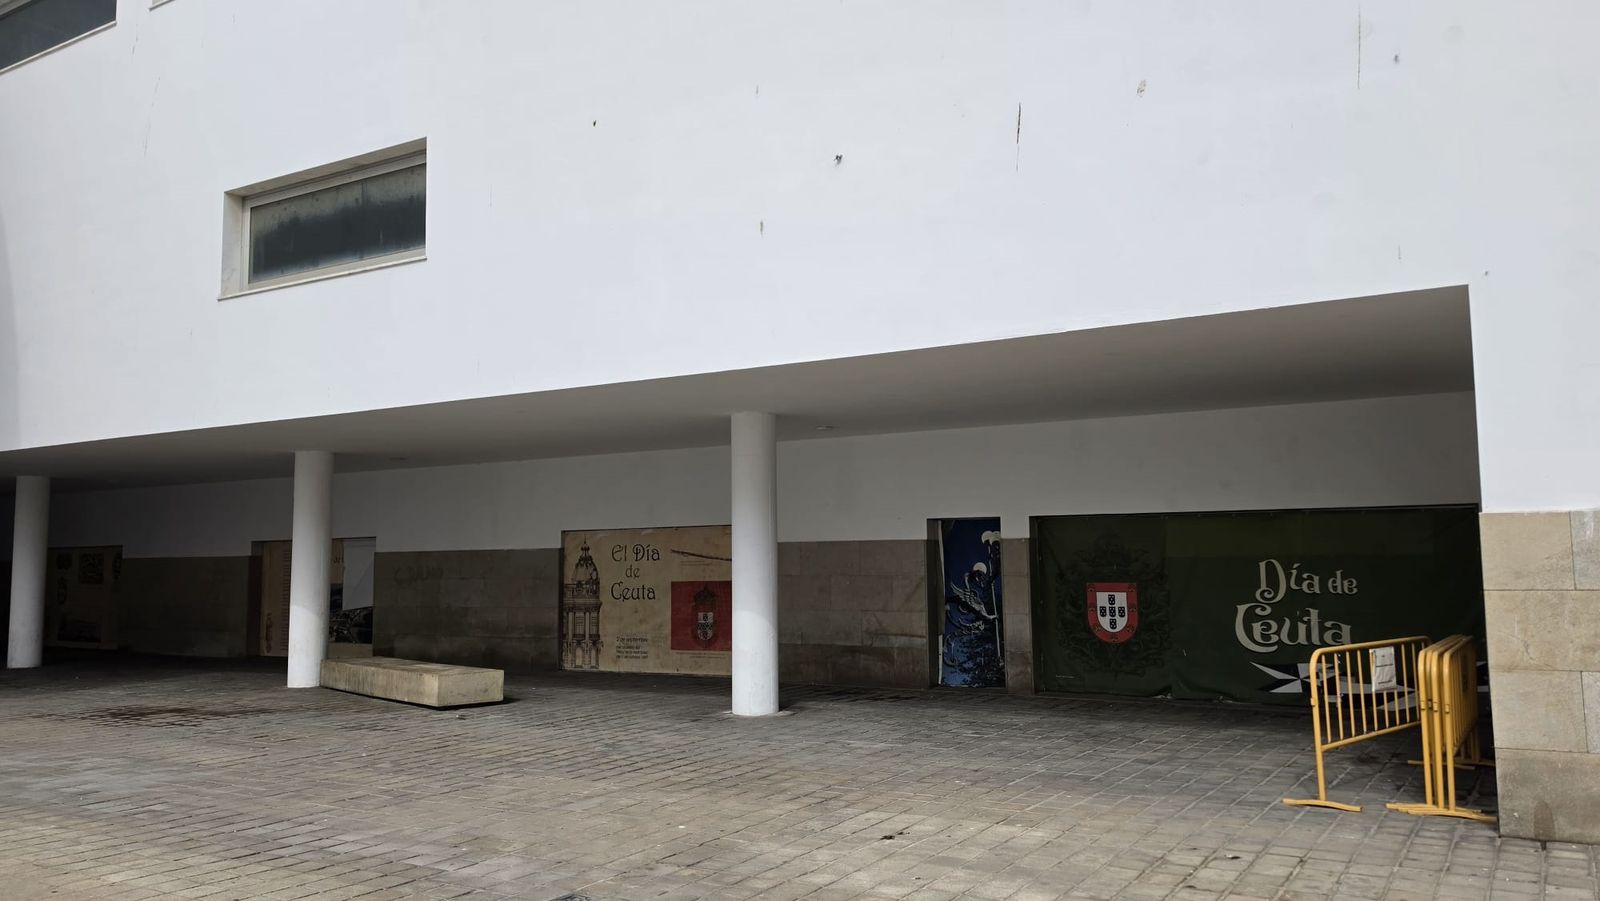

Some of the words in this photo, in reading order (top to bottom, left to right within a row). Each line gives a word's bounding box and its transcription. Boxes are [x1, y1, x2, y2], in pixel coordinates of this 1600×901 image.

[611, 544, 627, 562] El
[633, 543, 660, 562] Día
[625, 564, 640, 578] de
[1255, 559, 1320, 604] Día
[1329, 571, 1358, 595] de
[611, 581, 656, 602] Ceuta
[1235, 603, 1352, 653] Ceuta
